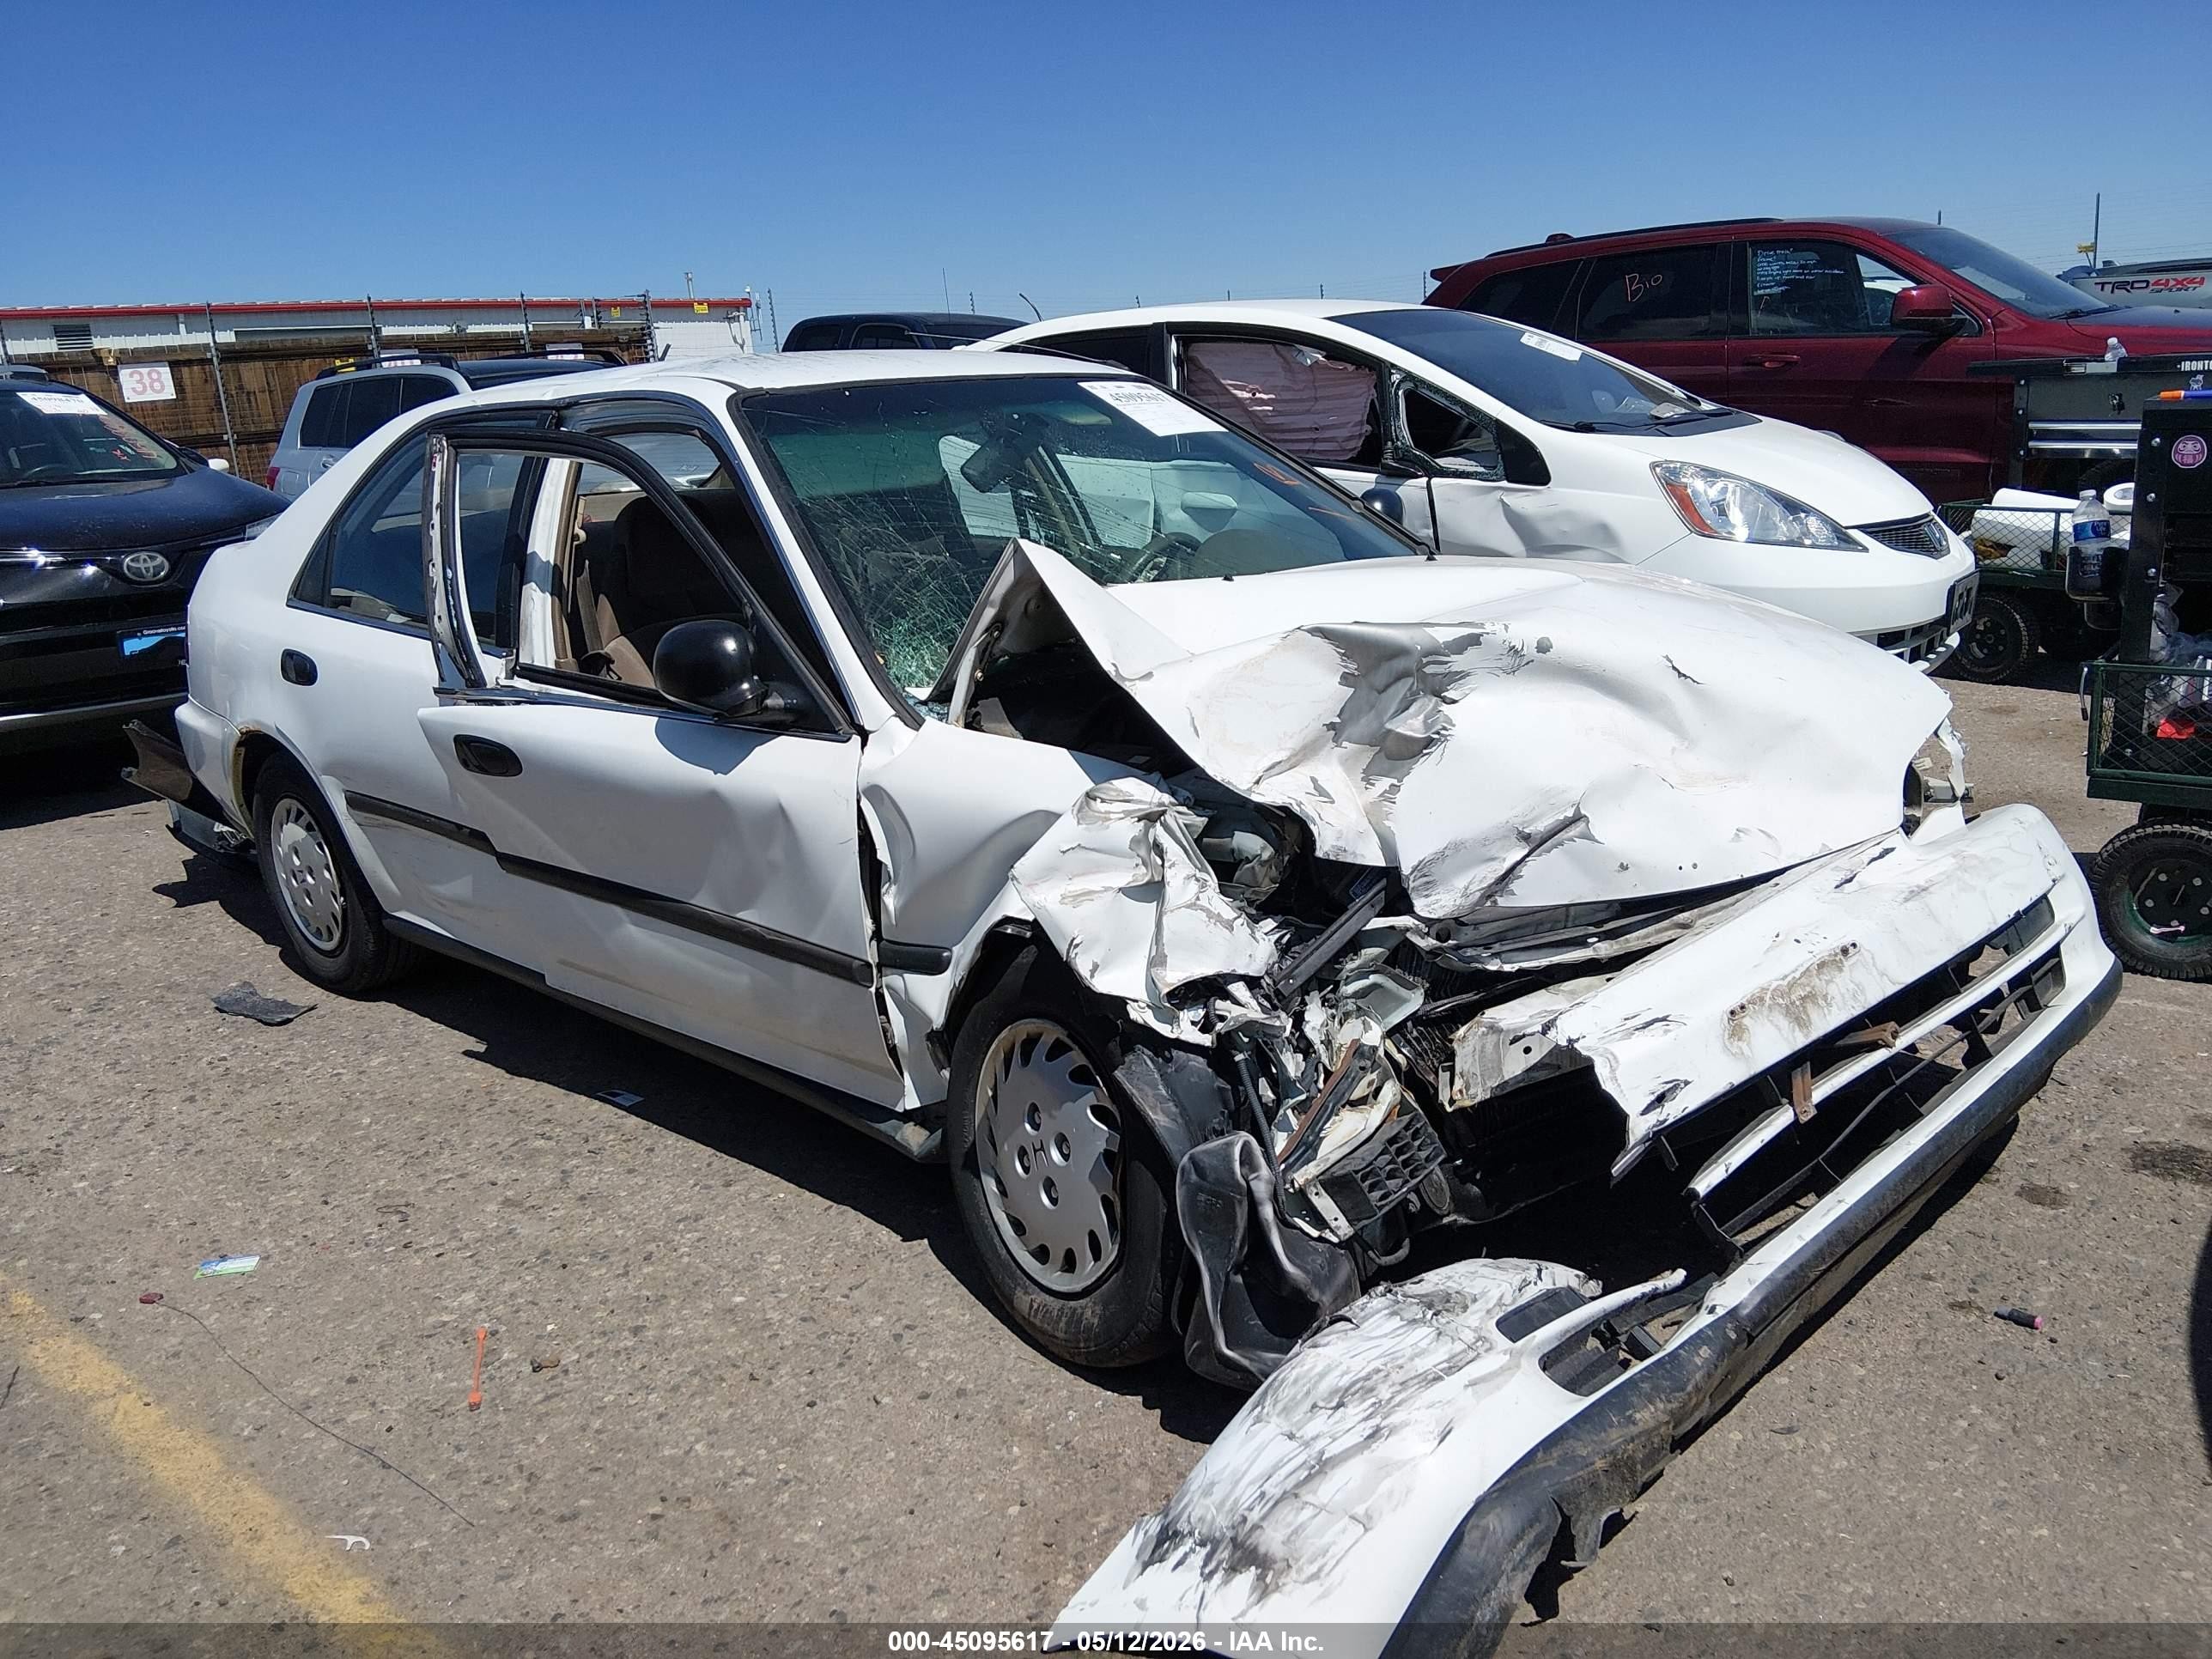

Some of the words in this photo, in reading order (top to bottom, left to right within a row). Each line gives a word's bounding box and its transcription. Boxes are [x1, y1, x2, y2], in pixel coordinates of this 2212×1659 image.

[2094, 279, 2150, 295] TRD
[2148, 285, 2202, 294] SPORT
[129, 368, 166, 395] 38
